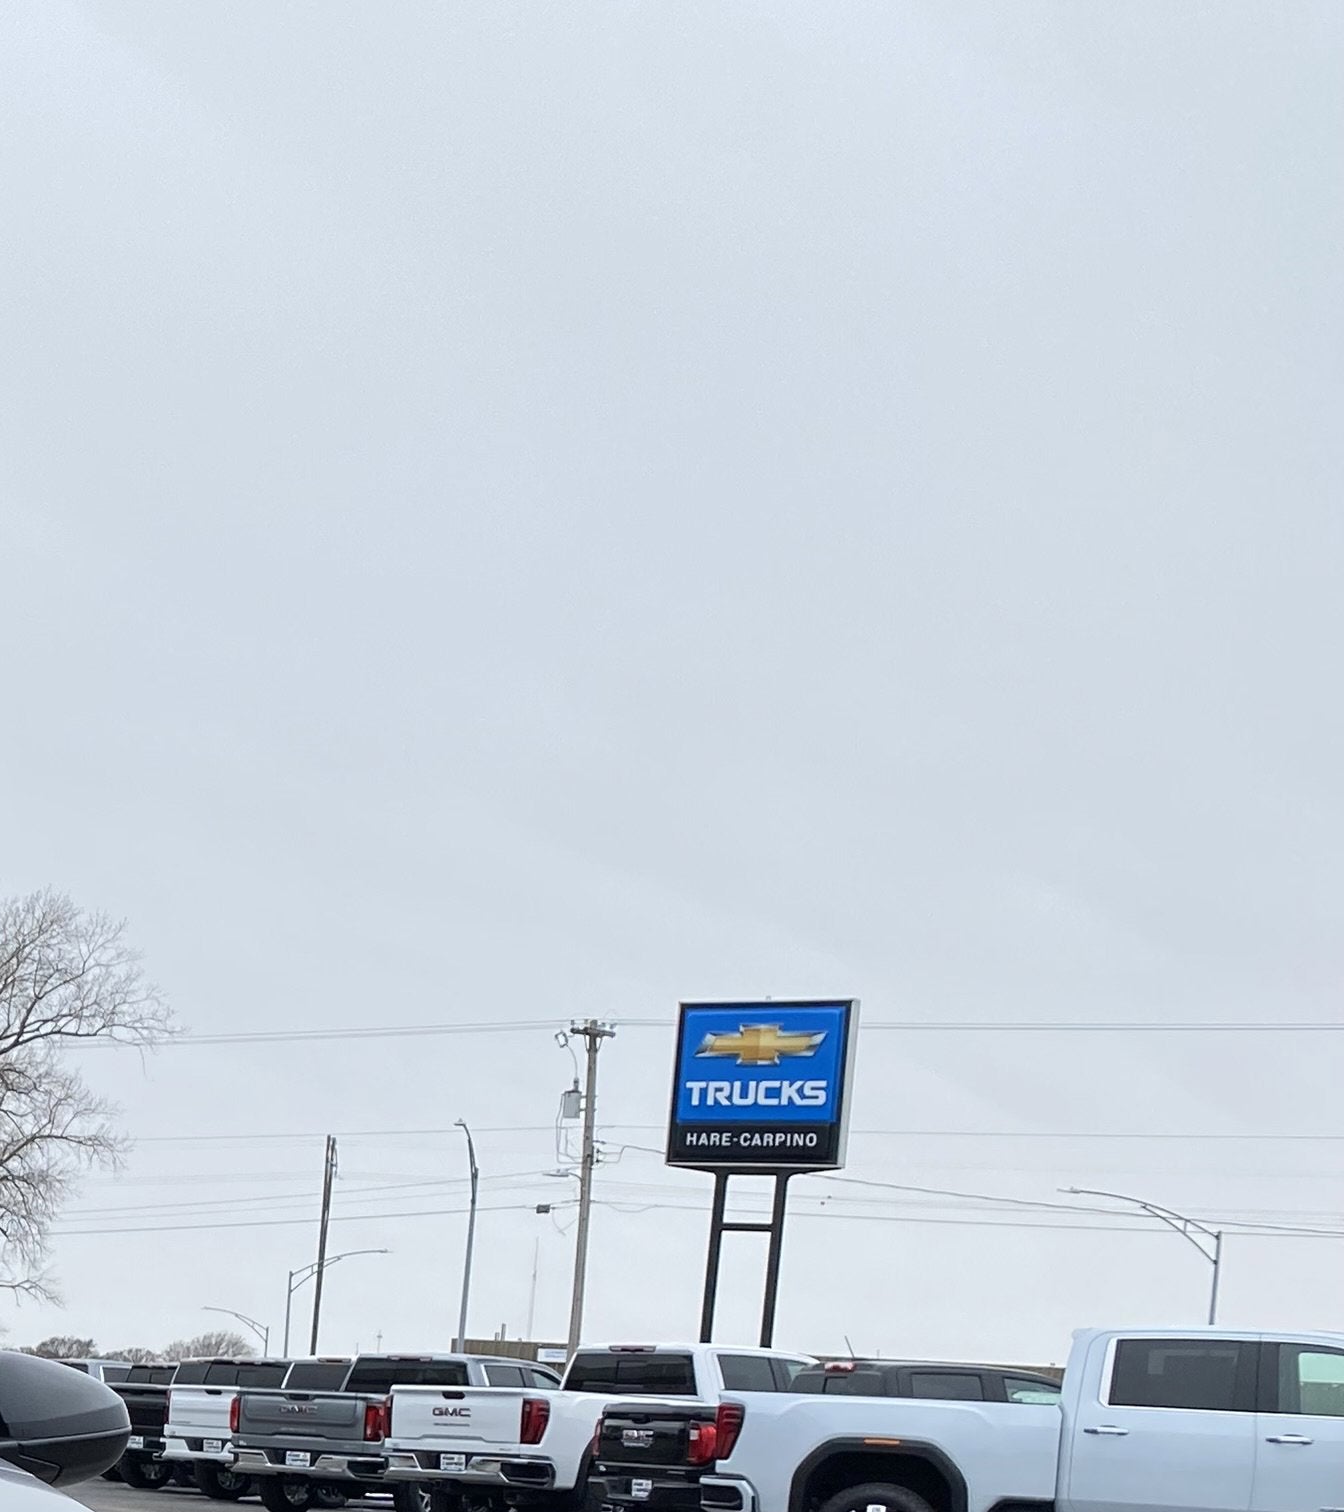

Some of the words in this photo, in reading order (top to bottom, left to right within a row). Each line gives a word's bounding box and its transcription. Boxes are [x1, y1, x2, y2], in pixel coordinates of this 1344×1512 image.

[685, 1079, 828, 1107] TRUCKS
[685, 1132, 818, 1148] HARE-CARPINO
[432, 1406, 472, 1418] GMC
